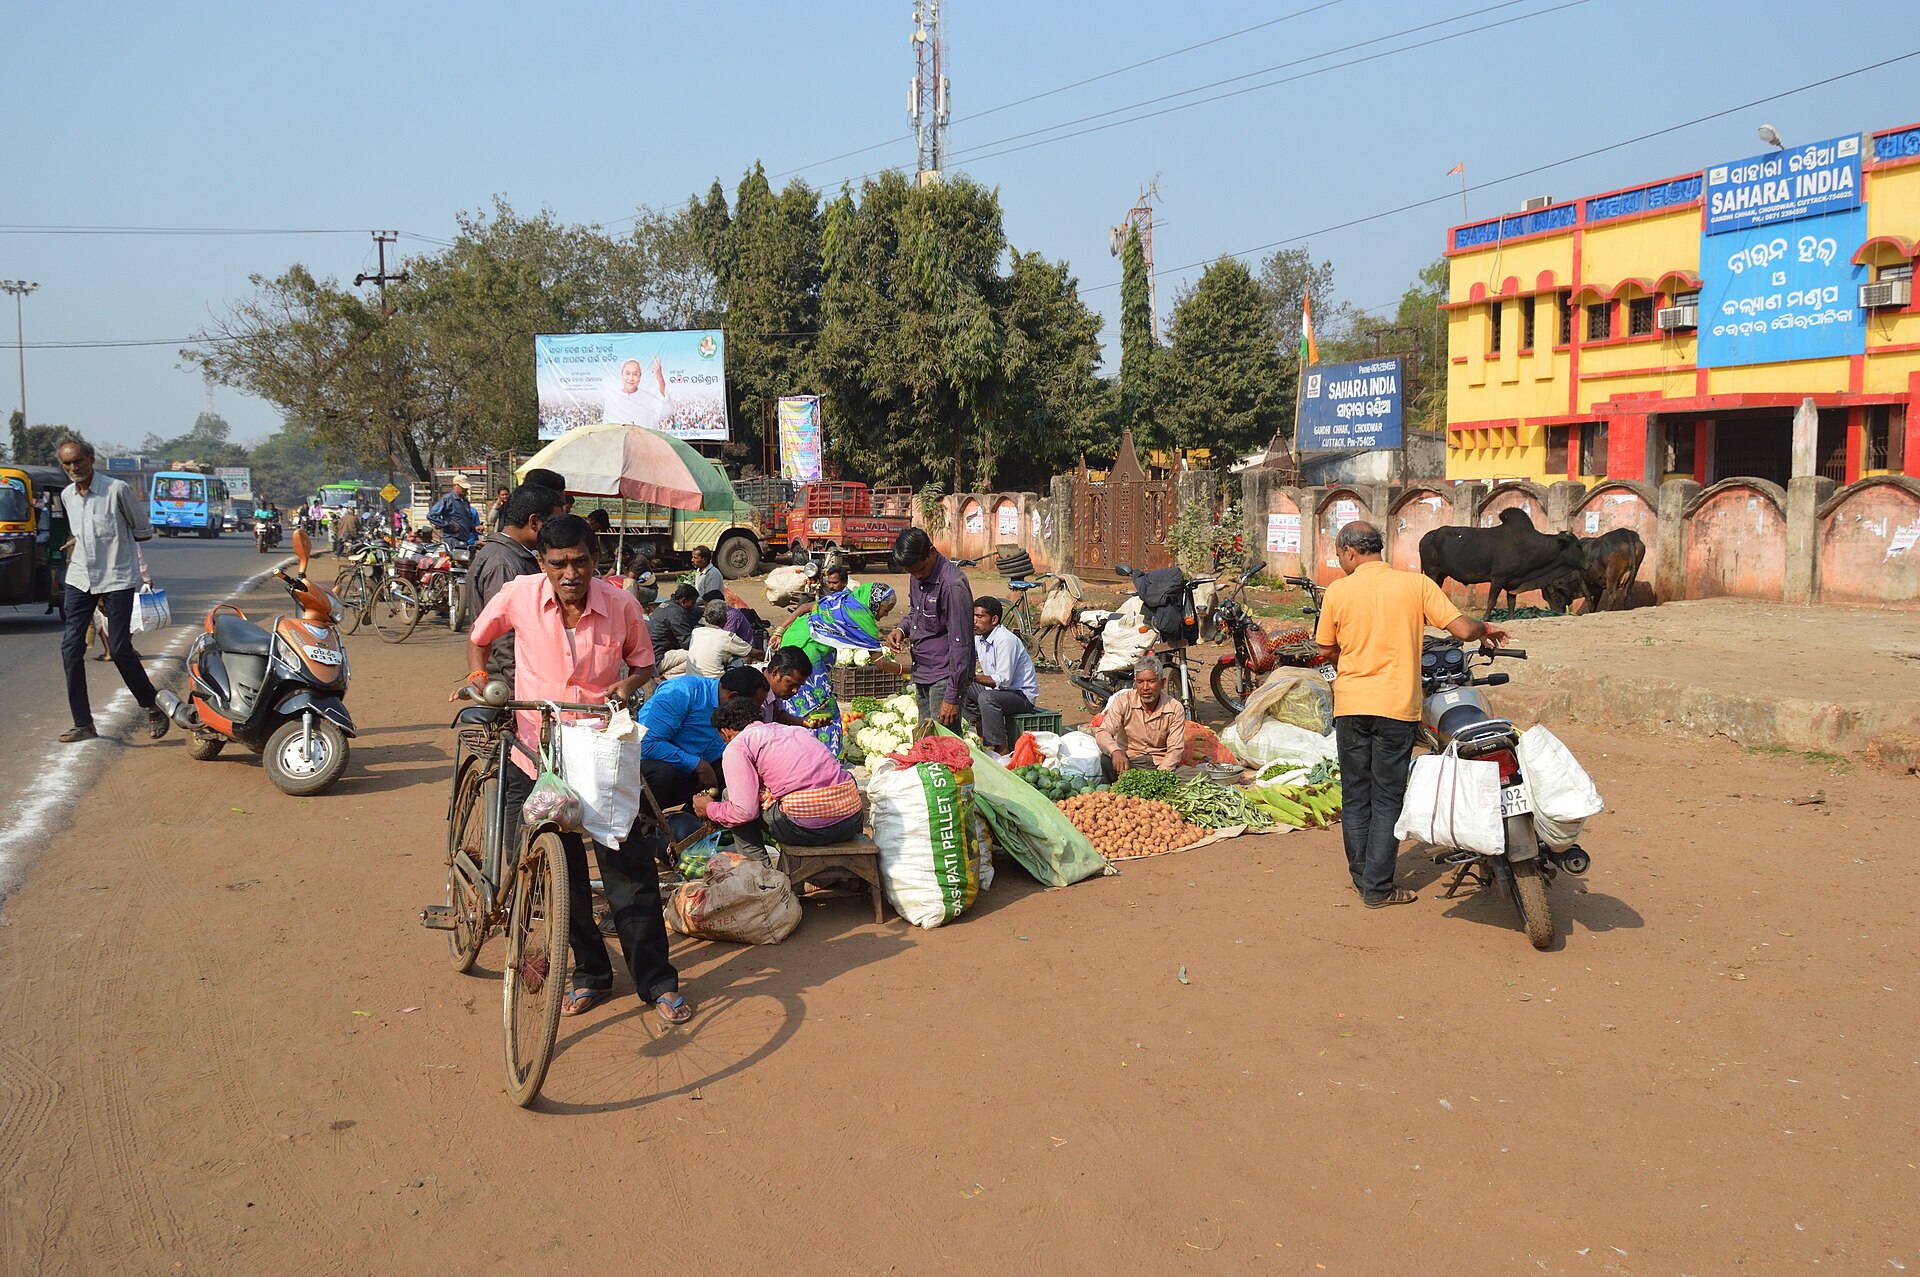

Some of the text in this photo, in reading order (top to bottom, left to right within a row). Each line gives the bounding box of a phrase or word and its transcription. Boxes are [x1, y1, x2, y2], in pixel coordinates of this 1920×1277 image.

[1730, 158, 1782, 185] ସାହାରା
[1711, 164, 1854, 215] SAHARA INDIA
[1711, 213, 1734, 223] GANDHI
[1798, 236, 1837, 267] ହଲ
[1772, 271, 1786, 286] ଓ
[1328, 375, 1396, 400] SAHARA INDIA
[1313, 426, 1331, 435] GANDHI
[1354, 423, 1383, 433] CHOUDWAR
[865, 521, 889, 531] TATA
[936, 796, 954, 850] PELLET
[717, 914, 737, 927] TEA
